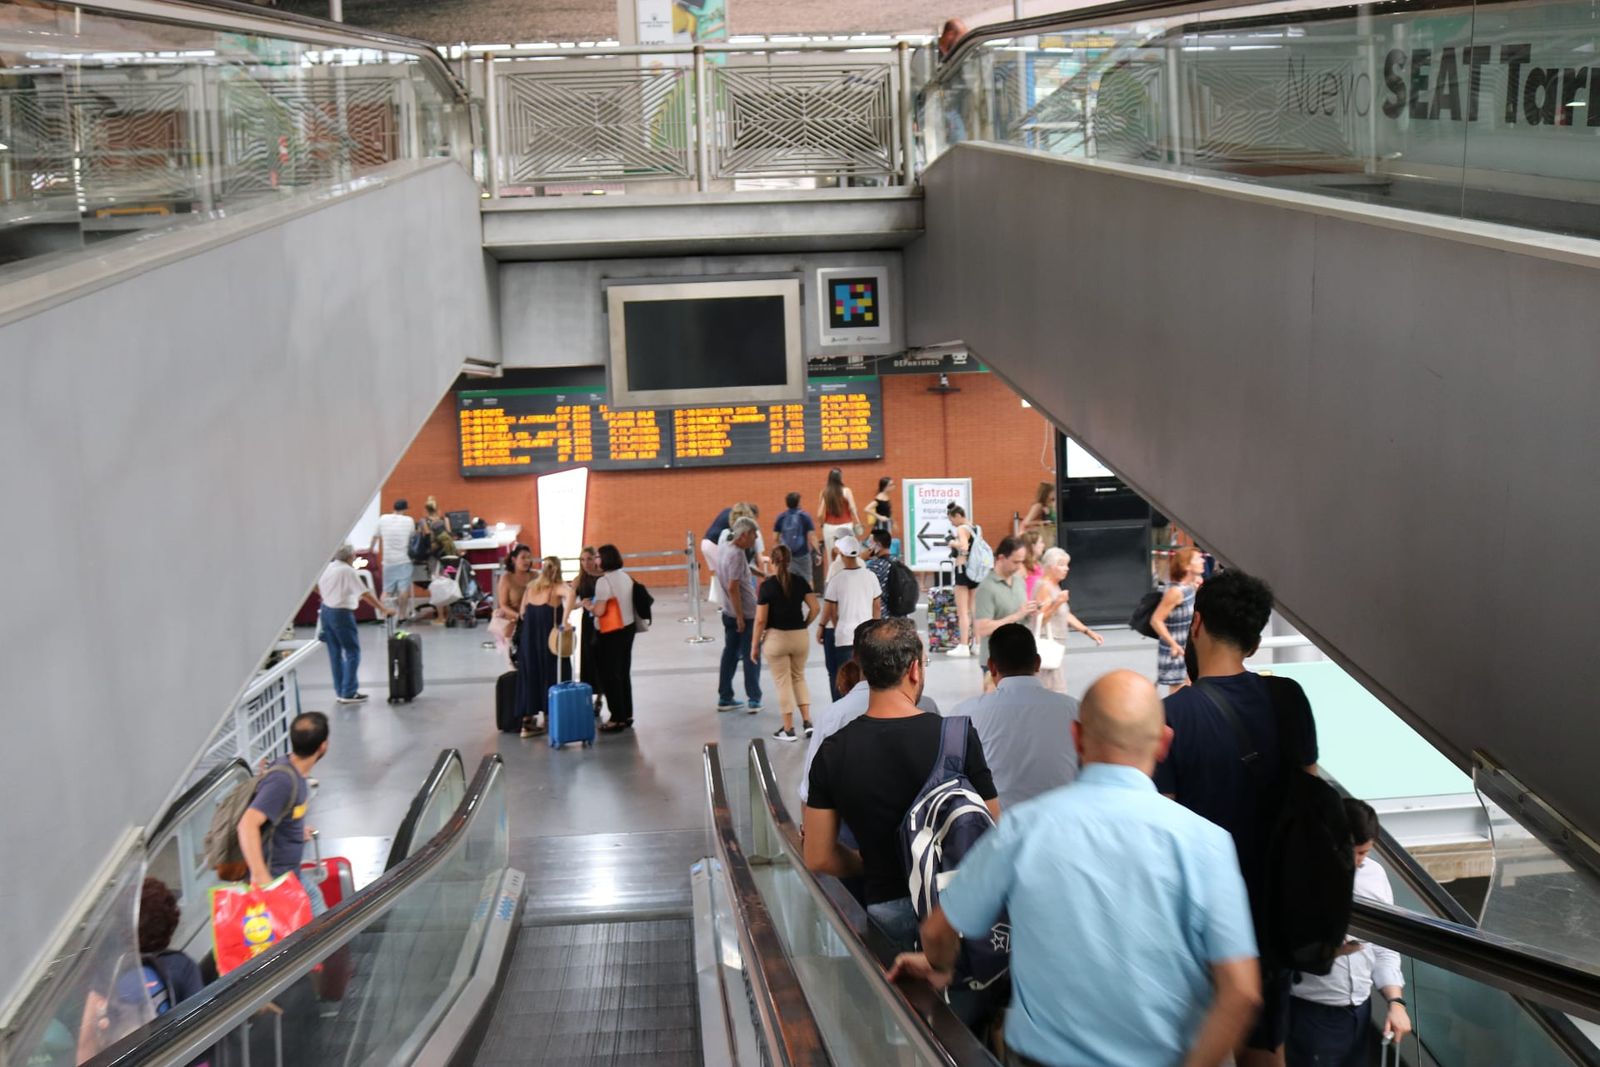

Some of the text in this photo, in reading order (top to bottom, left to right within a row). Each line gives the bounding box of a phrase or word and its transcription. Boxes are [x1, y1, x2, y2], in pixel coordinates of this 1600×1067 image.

[1287, 53, 1372, 117] Nuevo
[1382, 45, 1491, 121] SEAT
[918, 487, 960, 497] Entrada
